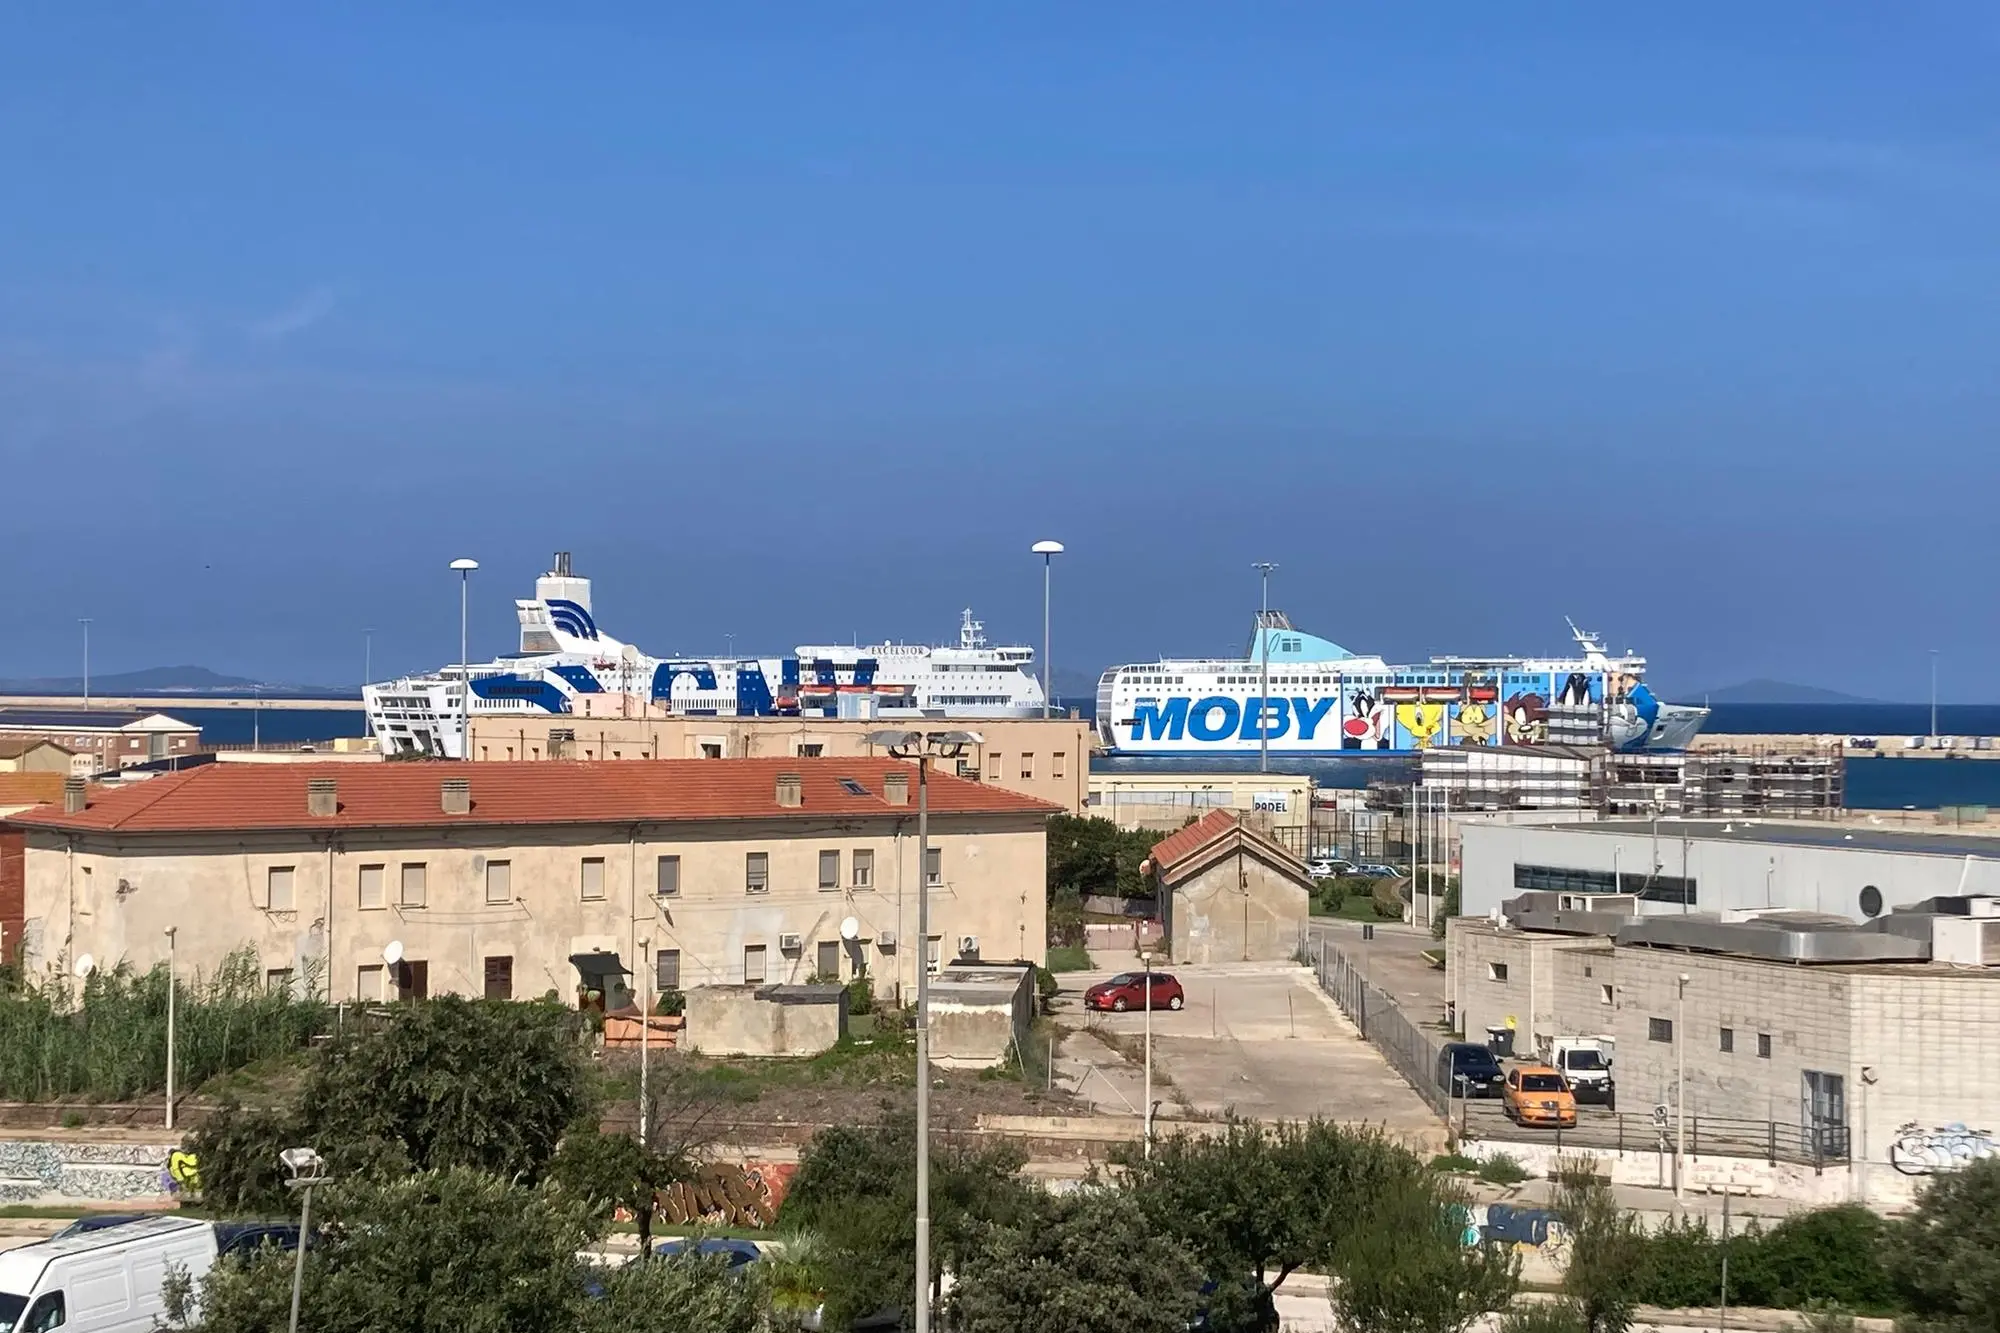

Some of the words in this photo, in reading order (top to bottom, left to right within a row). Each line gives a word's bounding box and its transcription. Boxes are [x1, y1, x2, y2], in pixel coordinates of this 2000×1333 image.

[871, 646, 924, 655] EXCELSIOR
[1131, 696, 1337, 741] MOBY
[1254, 802, 1287, 812] PADEL
